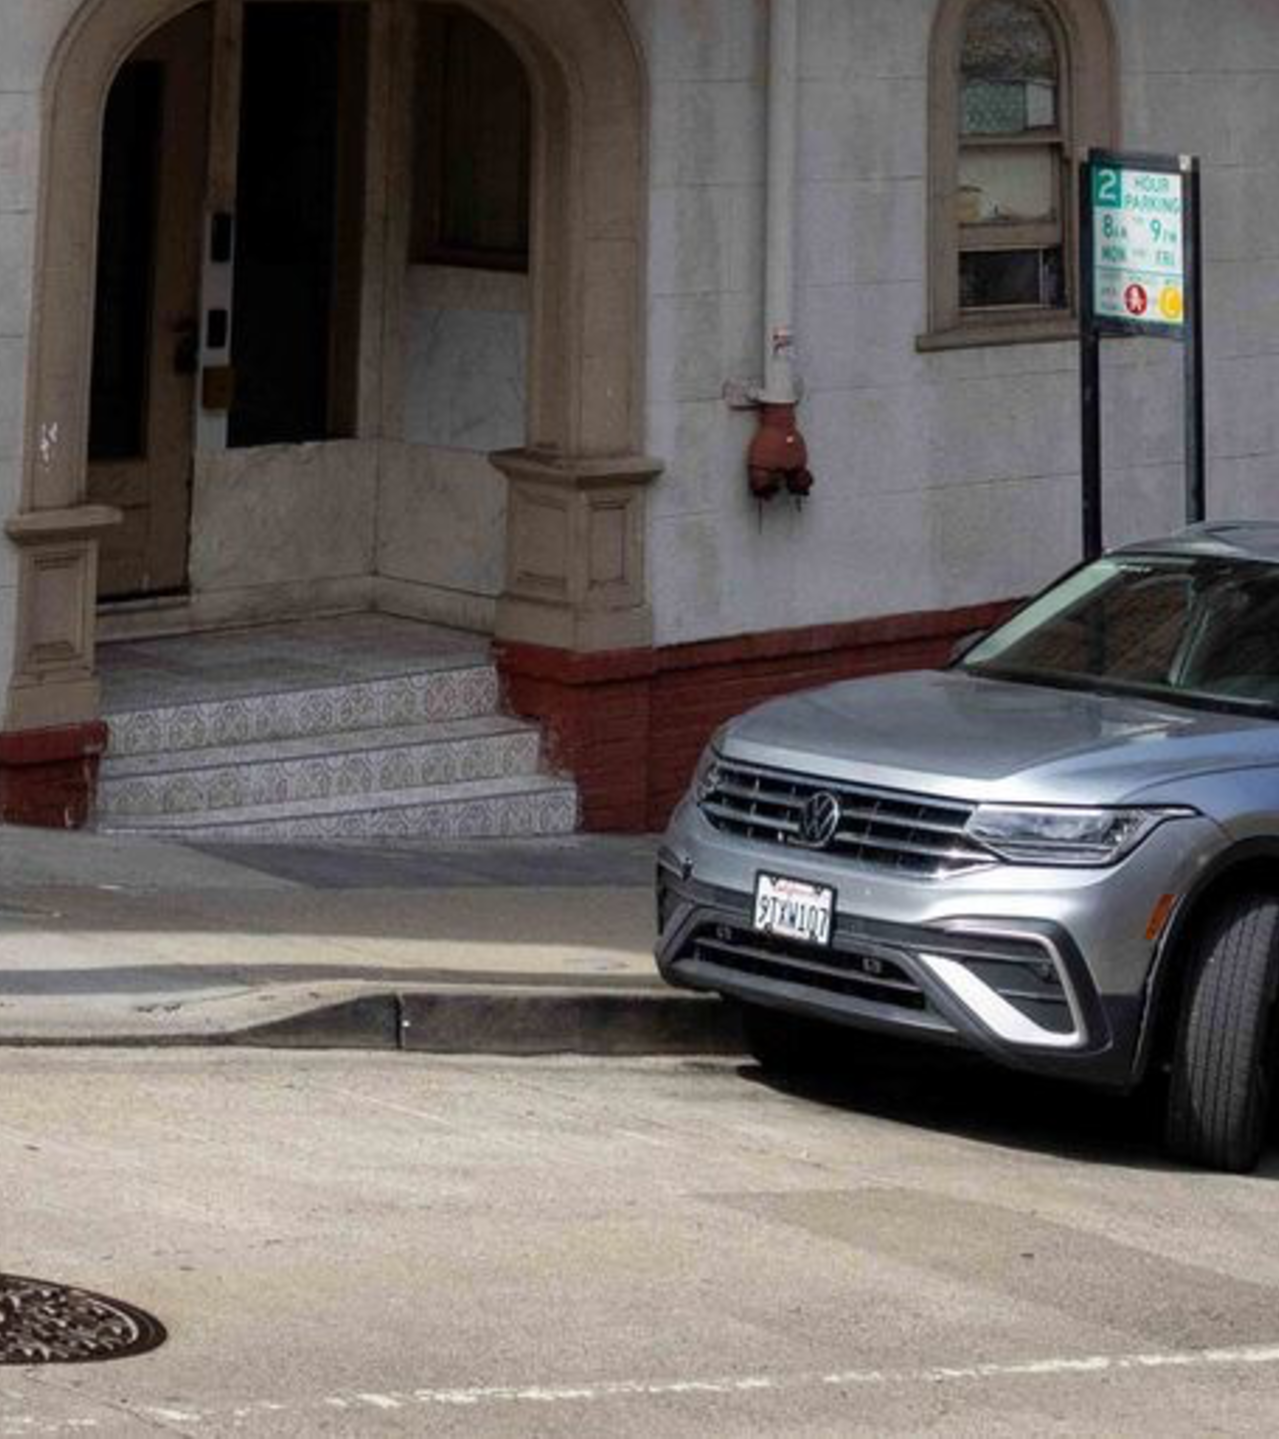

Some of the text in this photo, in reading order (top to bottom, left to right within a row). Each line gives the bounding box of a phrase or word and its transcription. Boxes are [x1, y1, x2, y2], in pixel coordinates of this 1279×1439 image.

[1098, 169, 1117, 199] 2
[1133, 175, 1169, 193] HOUR
[1124, 194, 1181, 215] PARKING
